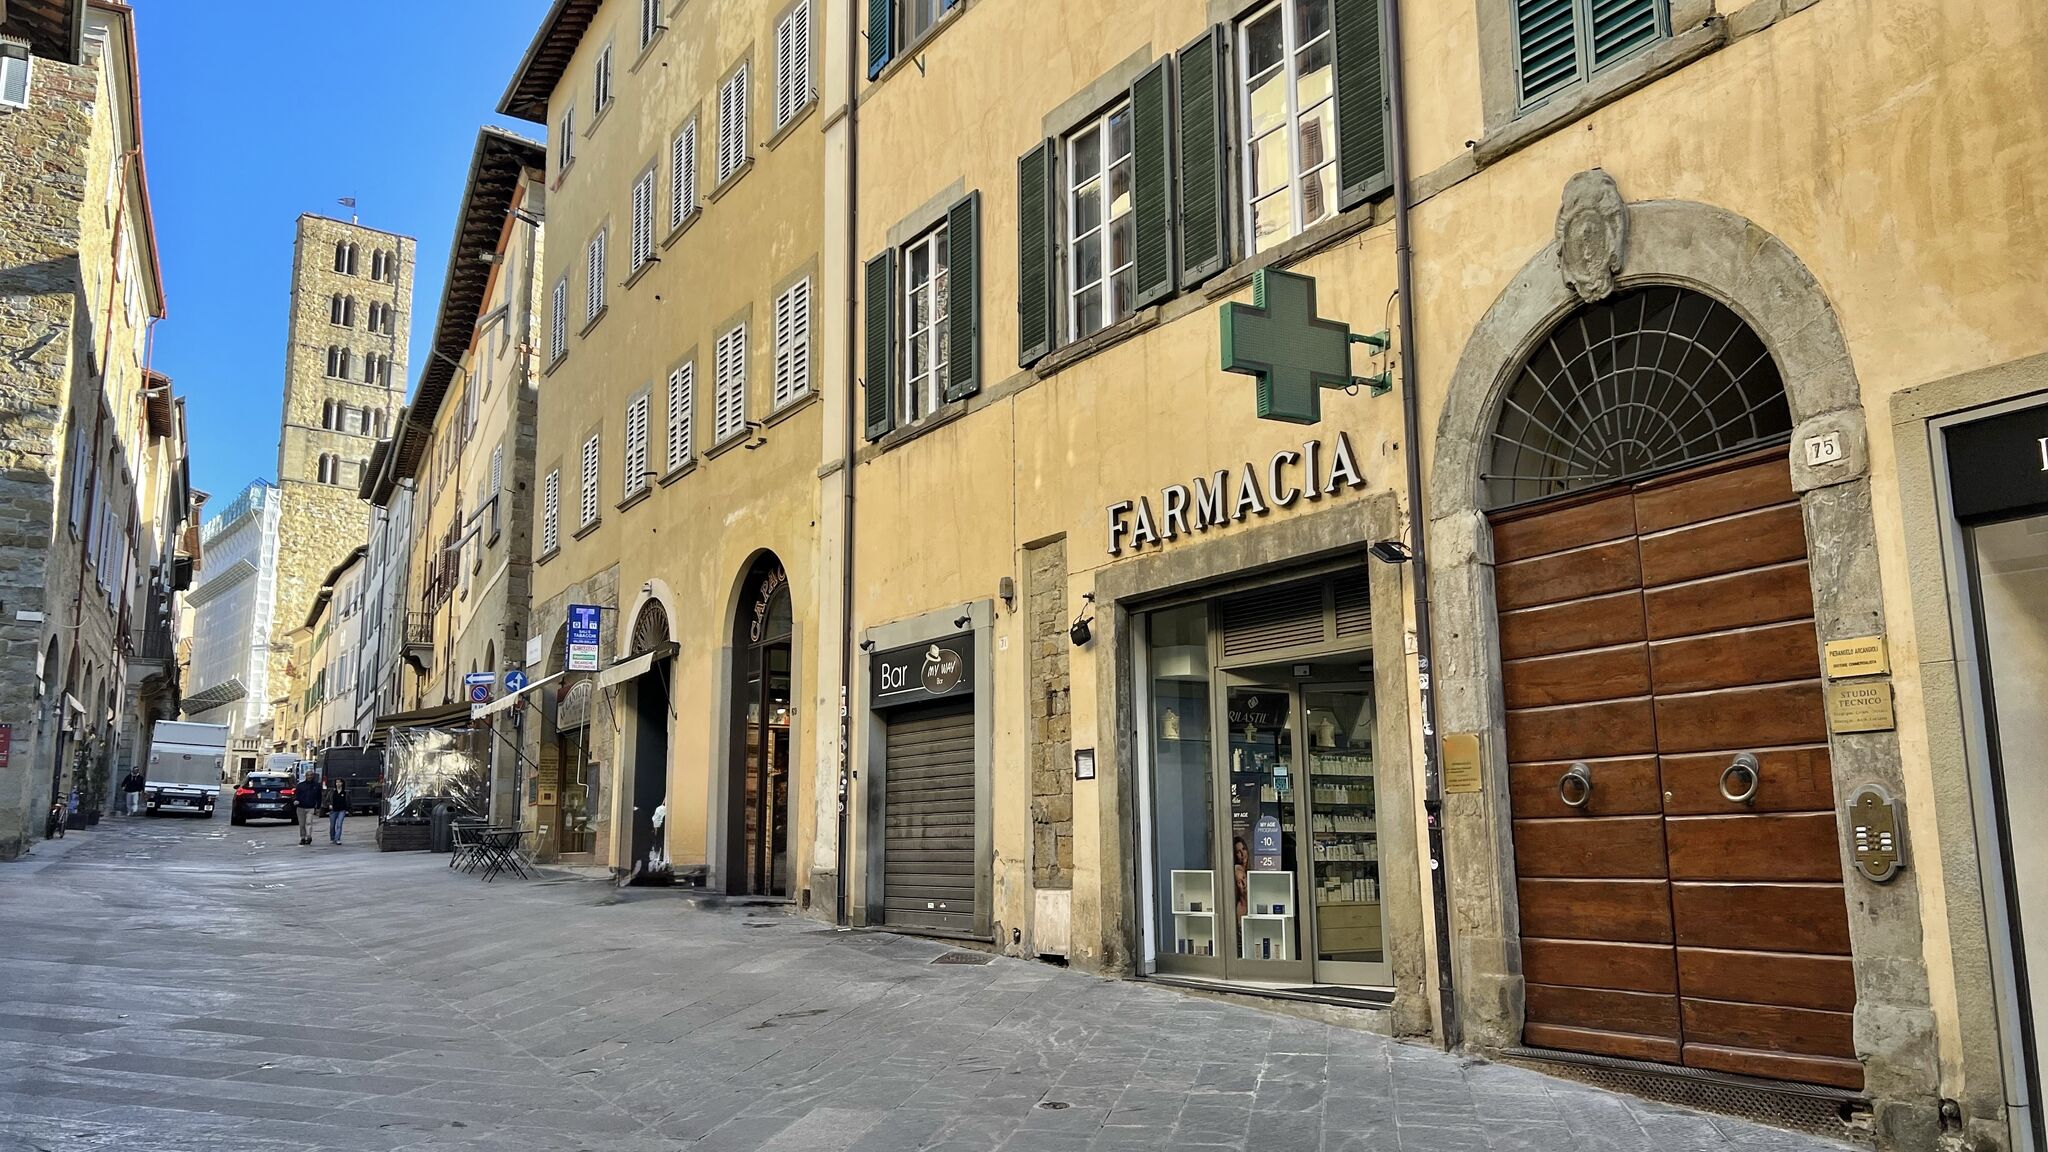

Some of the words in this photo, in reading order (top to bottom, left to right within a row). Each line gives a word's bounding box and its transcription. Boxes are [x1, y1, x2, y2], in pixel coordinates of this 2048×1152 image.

[1811, 439, 1834, 459] 75
[1106, 431, 1367, 556] FARMACIA
[576, 608, 595, 630] T
[881, 663, 908, 690] Bar
[927, 663, 940, 678] MY
[941, 660, 956, 675] WAY
[1839, 697, 1882, 707] TECNICO
[1840, 689, 1877, 698] STUDIO
[1229, 710, 1267, 724] RILASTIL
